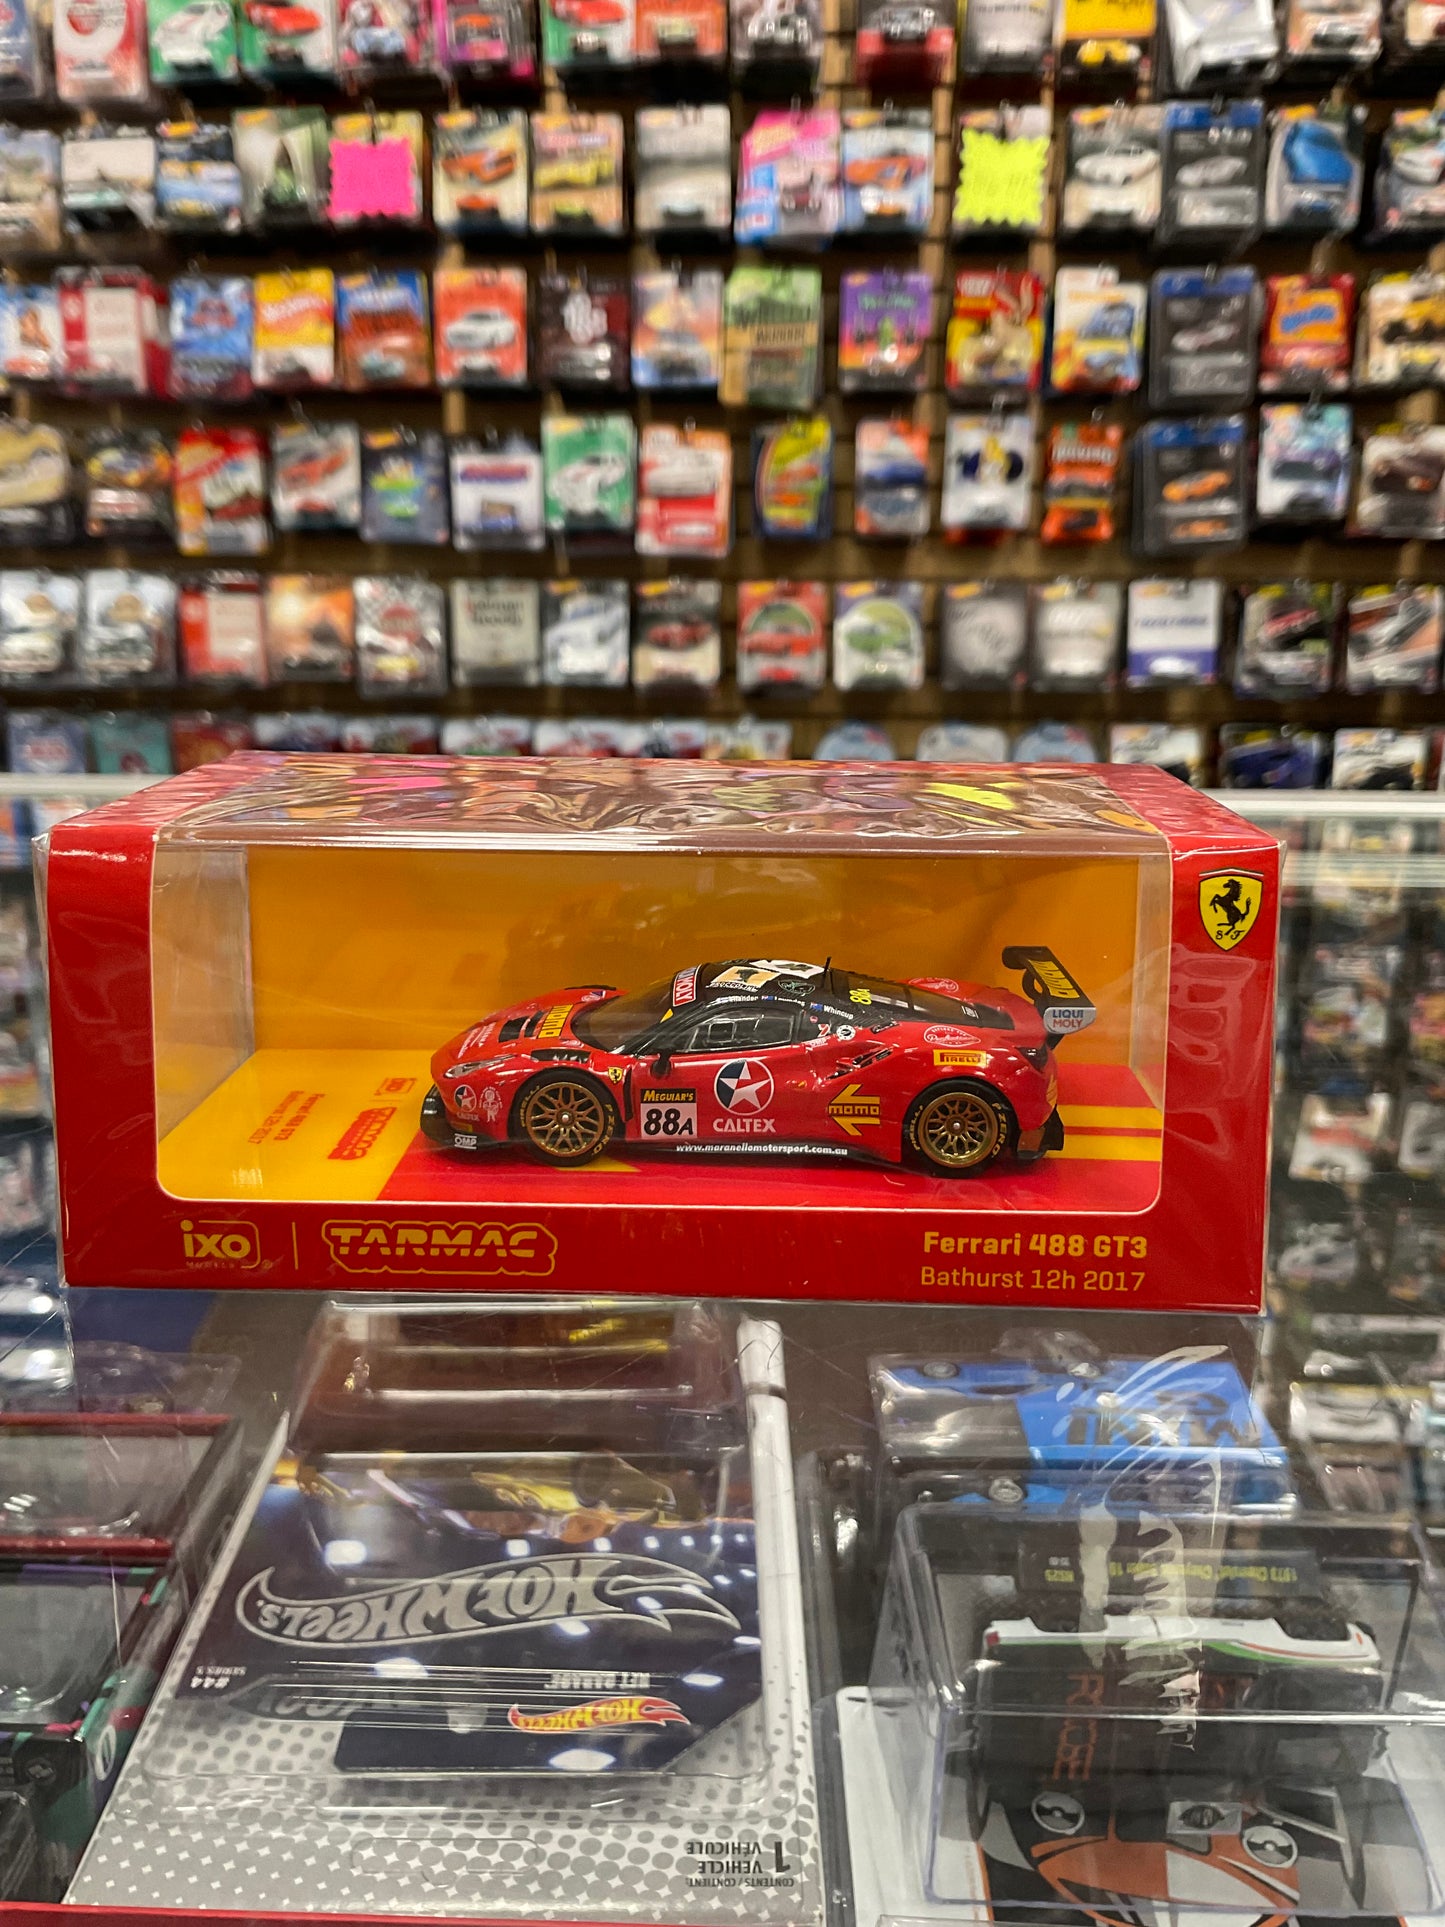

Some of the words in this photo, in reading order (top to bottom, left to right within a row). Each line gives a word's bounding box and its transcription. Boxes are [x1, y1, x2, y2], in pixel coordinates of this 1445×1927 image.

[823, 1005, 854, 1020] Whincup
[1052, 1009, 1084, 1019] LIQUI
[1052, 1019, 1083, 1029] MOLY
[939, 1052, 982, 1062] PIRELLI
[643, 1090, 694, 1102] MEGUIAR'S
[828, 1104, 881, 1115] momo
[643, 1108, 694, 1136] 88A
[712, 1118, 776, 1133] CALTEX
[676, 1143, 848, 1156] www.maranellomotorsport.com.au
[330, 1227, 538, 1258] TARMAC
[923, 1231, 1021, 1256] Ferrari
[1028, 1233, 1086, 1257] 488
[1093, 1235, 1148, 1259] GT3
[921, 1266, 1024, 1289] Bathurst
[1031, 1269, 1076, 1290] 12h
[1083, 1271, 1146, 1291] 2017
[686, 1841, 762, 1857] VÉHICULE
[774, 1841, 791, 1873] 1
[698, 1860, 763, 1874] VEHICLE
[745, 1877, 794, 1887] CONTENTS
